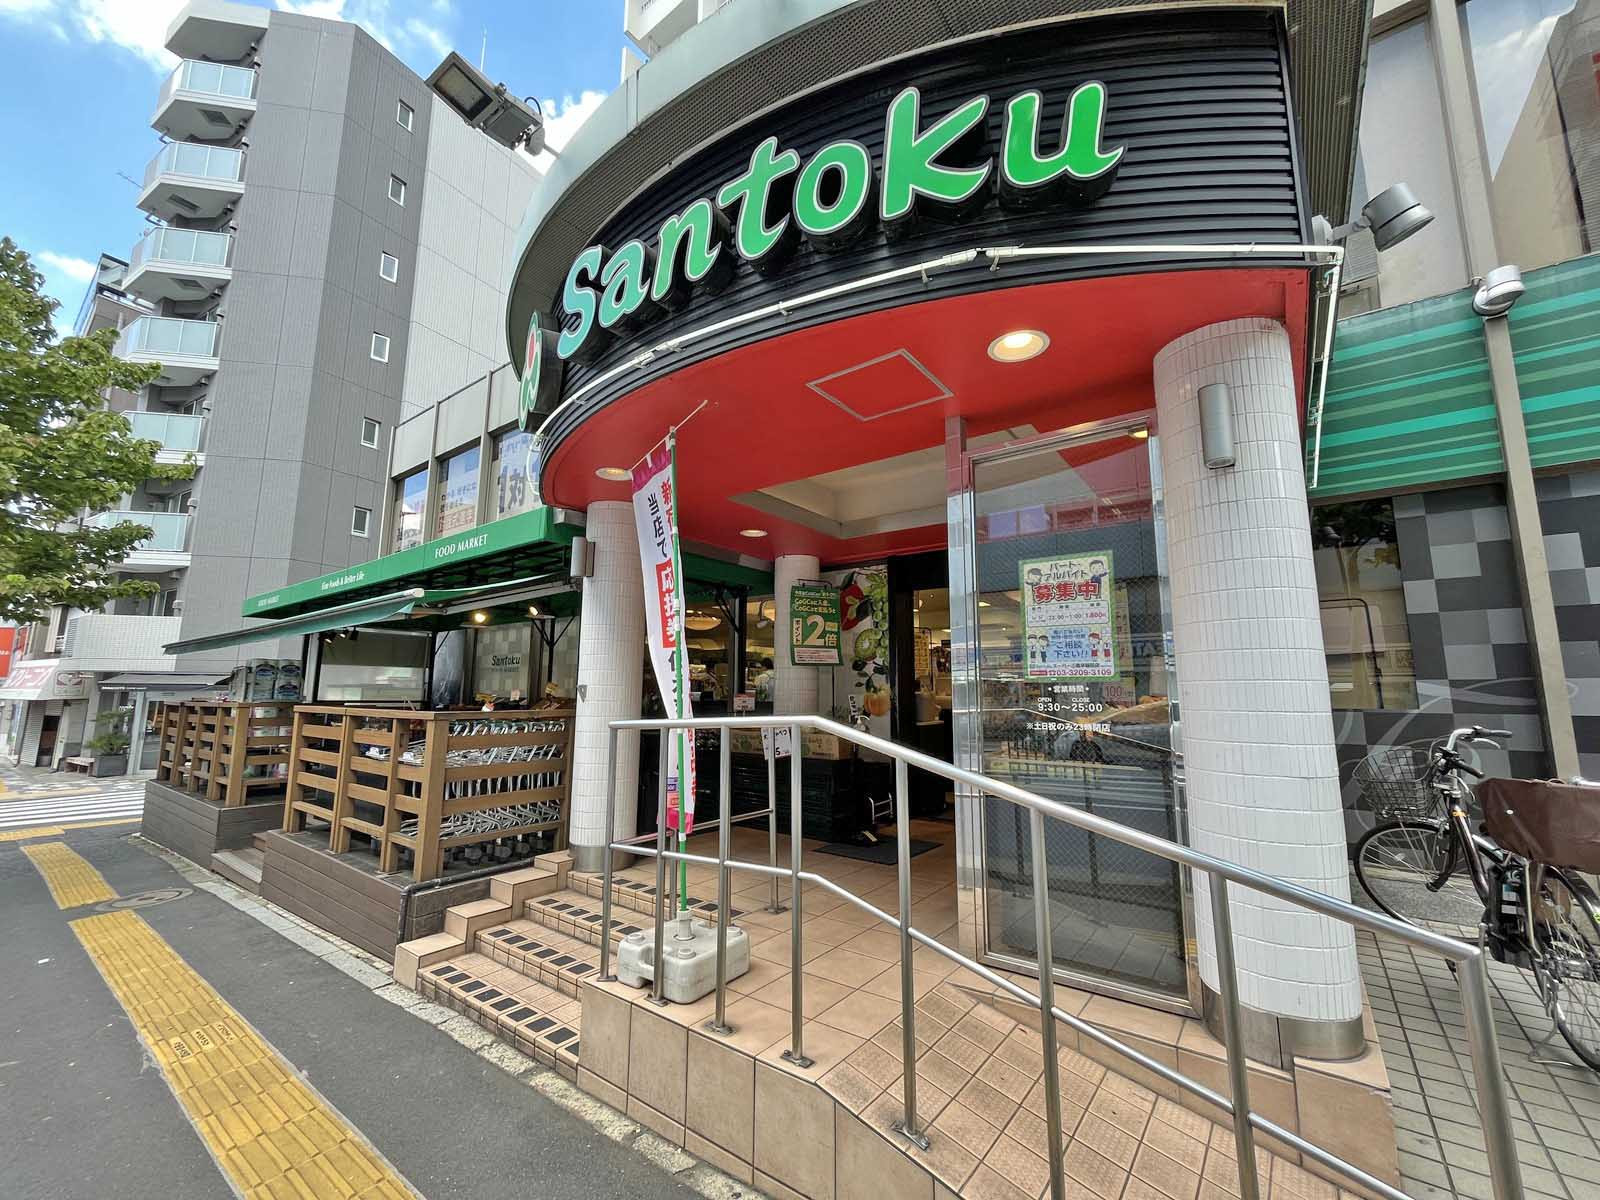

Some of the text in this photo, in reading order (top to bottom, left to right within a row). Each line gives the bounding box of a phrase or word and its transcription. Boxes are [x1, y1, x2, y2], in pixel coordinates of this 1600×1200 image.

[557, 80, 1125, 360] Santoku
[647, 492, 668, 558] 当店で
[434, 533, 489, 559] FOOD MARKET
[1044, 570, 1088, 581] アルバイト
[1033, 580, 1099, 604] 募集中
[804, 614, 825, 646] 2
[826, 633, 838, 646] 倍
[491, 655, 521, 666] Santoku
